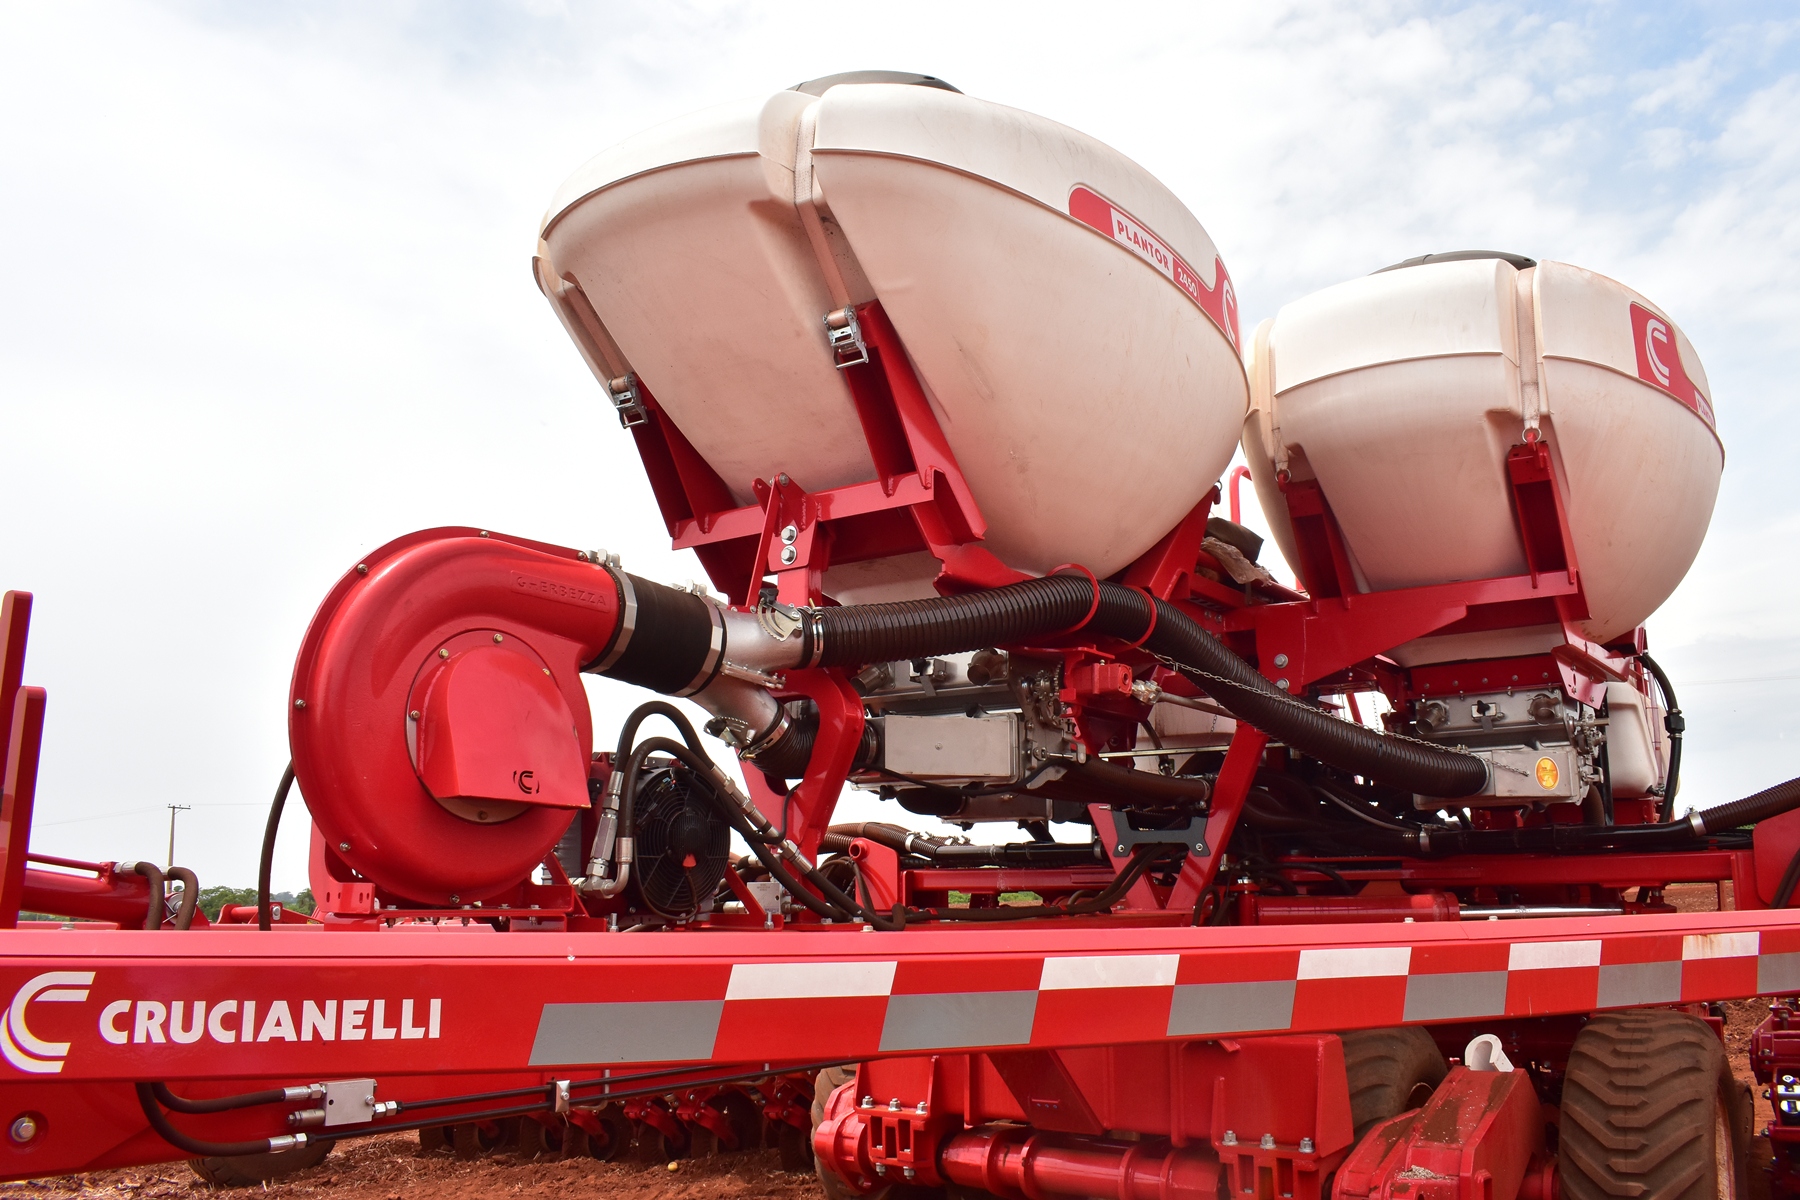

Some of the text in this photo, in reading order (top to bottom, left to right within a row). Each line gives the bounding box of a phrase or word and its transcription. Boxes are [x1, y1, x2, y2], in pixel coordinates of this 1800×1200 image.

[1116, 219, 1198, 298] PLANTOR 2450
[99, 998, 442, 1045] CRUCIANELLI
